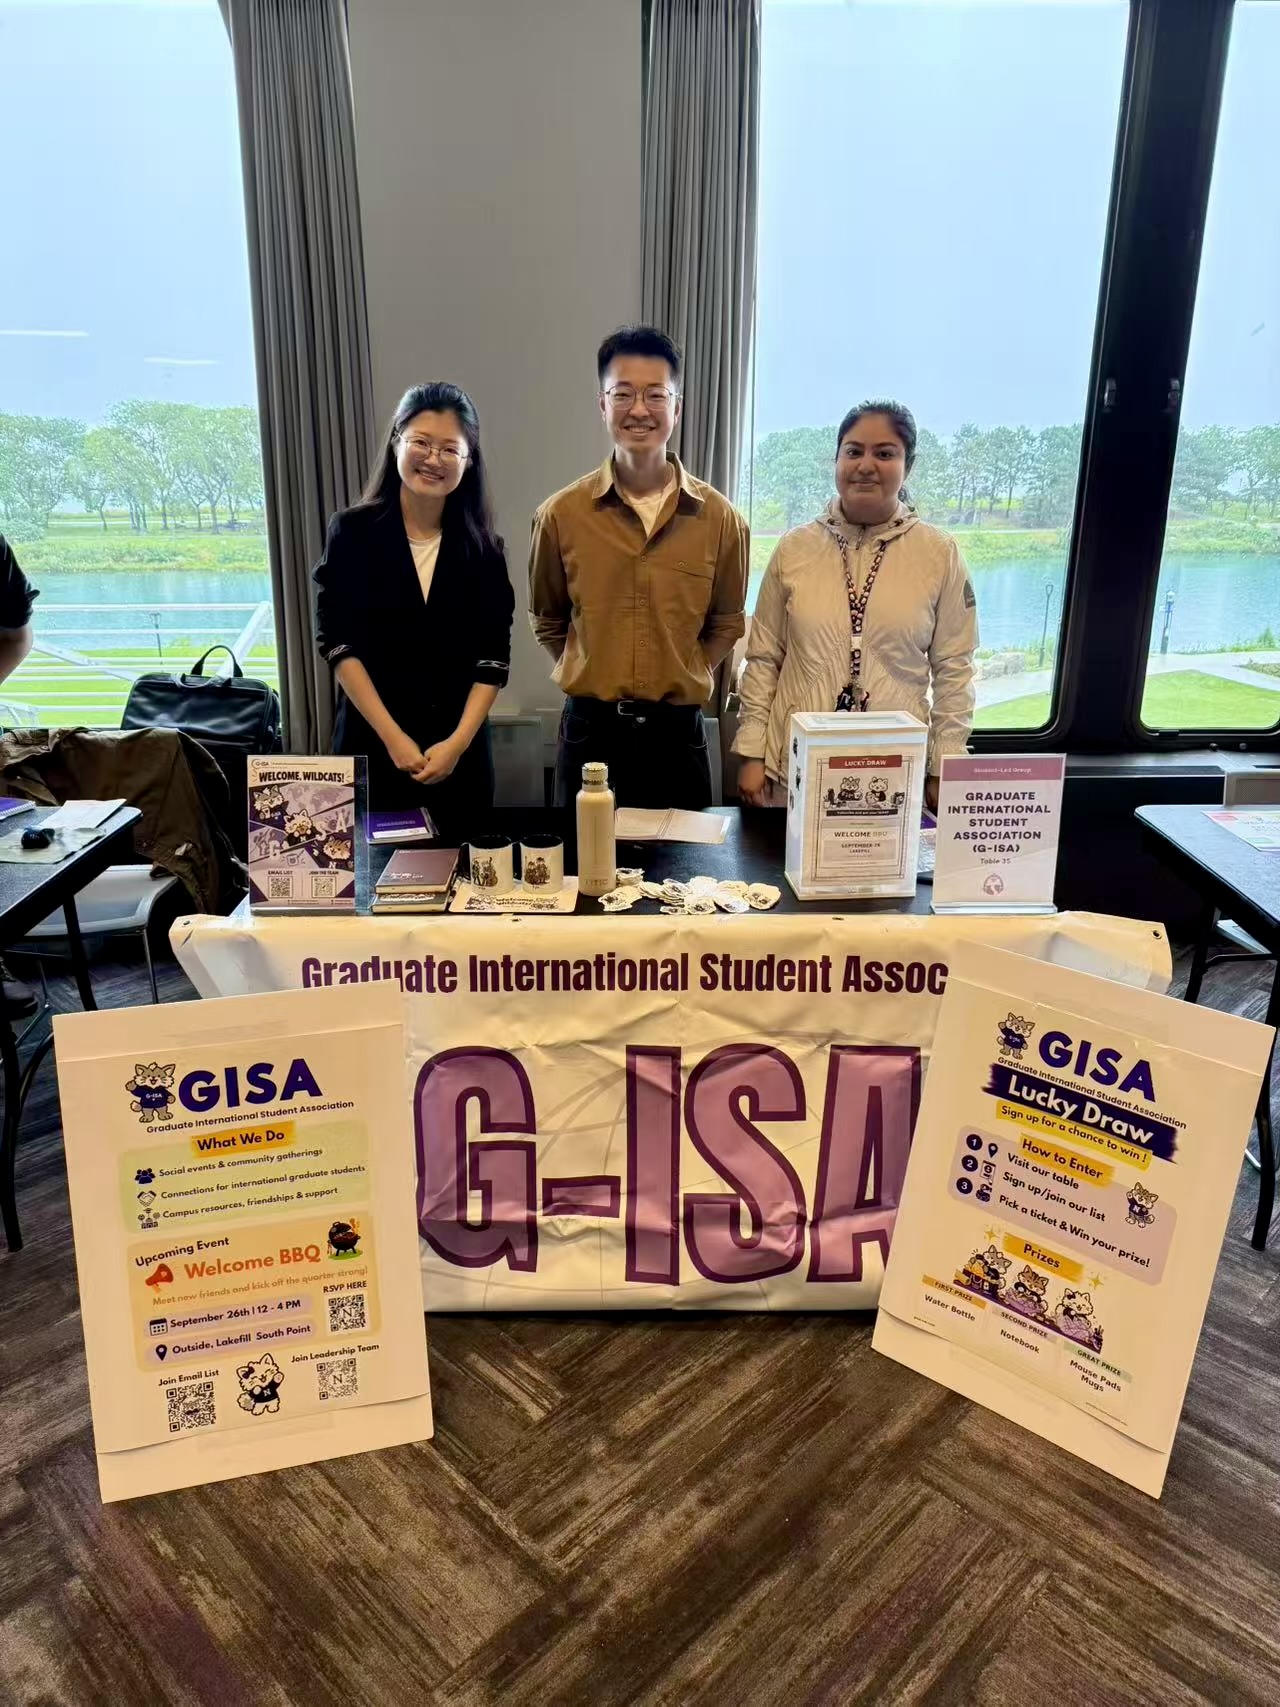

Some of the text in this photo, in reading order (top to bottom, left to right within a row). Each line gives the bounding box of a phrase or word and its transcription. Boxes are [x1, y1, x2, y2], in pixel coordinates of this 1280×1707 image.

[303, 772, 344, 782] WILDCATS!
[948, 805, 1051, 814] INTERNATIONAL
[965, 792, 1036, 801] GRADUATE
[953, 832, 1041, 840] ASSOCIATION
[970, 818, 1028, 827] STUDENT
[973, 844, 1020, 853] (G-ISA)
[301, 954, 458, 993] Graduate
[469, 952, 689, 993] International
[699, 953, 832, 993] Student
[1038, 1031, 1156, 1103] GISA
[178, 1058, 323, 1112] GISA
[998, 1056, 1187, 1130] Graduate International Student Association
[146, 1100, 354, 1134] Graduate International Student Association
[1008, 1074, 1154, 1144] Lucky Draw
[197, 1130, 284, 1150] What We Do
[1002, 1105, 1024, 1121] Sign
[1026, 1114, 1039, 1126] up
[1041, 1115, 1057, 1128] for
[1058, 1124, 1066, 1132] a
[1068, 1125, 1104, 1146] chance
[1106, 1139, 1118, 1150] to
[1120, 1145, 1140, 1160] win
[158, 1148, 323, 1177] Social events & community gatherings
[414, 1043, 921, 1286] G-ISA
[1008, 1152, 1030, 1170] Visit
[1031, 1165, 1050, 1178] our
[1052, 1170, 1080, 1190] table
[1022, 1138, 1104, 1180] How to Enter
[160, 1164, 366, 1199] Connections for international graduate students
[966, 1160, 1106, 1222] 2 Sign up/join our list
[162, 1186, 338, 1219] Campus resources, friendships & support
[961, 1182, 1151, 1268] 3 Pick a ticket & Win your prize!
[135, 1237, 230, 1267] Upcoming Event
[184, 1244, 322, 1280] Welcome BBQ
[1023, 1243, 1060, 1268] Prizes
[152, 1295, 176, 1306] Meet
[198, 1288, 231, 1299] friends
[232, 1285, 251, 1294] and
[252, 1281, 271, 1291] kick
[271, 1278, 285, 1288] off
[286, 1276, 301, 1285] the
[302, 1272, 335, 1283] quarter
[323, 1280, 368, 1294] RSVP HERE
[934, 1280, 973, 1302] FIRST PRIZE
[170, 1313, 224, 1328] September
[226, 1306, 250, 1319] 26th
[256, 1304, 268, 1314] 12
[276, 1302, 284, 1311] 4
[285, 1300, 301, 1310] PM
[924, 1294, 950, 1310] Water
[951, 1304, 976, 1322] Bottle
[172, 1324, 312, 1354] Outside, Lakefill South Point
[1001, 1311, 1048, 1339] SECOND PRIZE
[290, 1343, 380, 1364] Join Leadership Team
[1000, 1329, 1040, 1354] Notebook
[1070, 1360, 1122, 1392] Mouse Pads
[1077, 1349, 1122, 1376] GREAT PRIZE
[158, 1368, 220, 1388] Join Email List
[1080, 1374, 1104, 1392] Mugs
